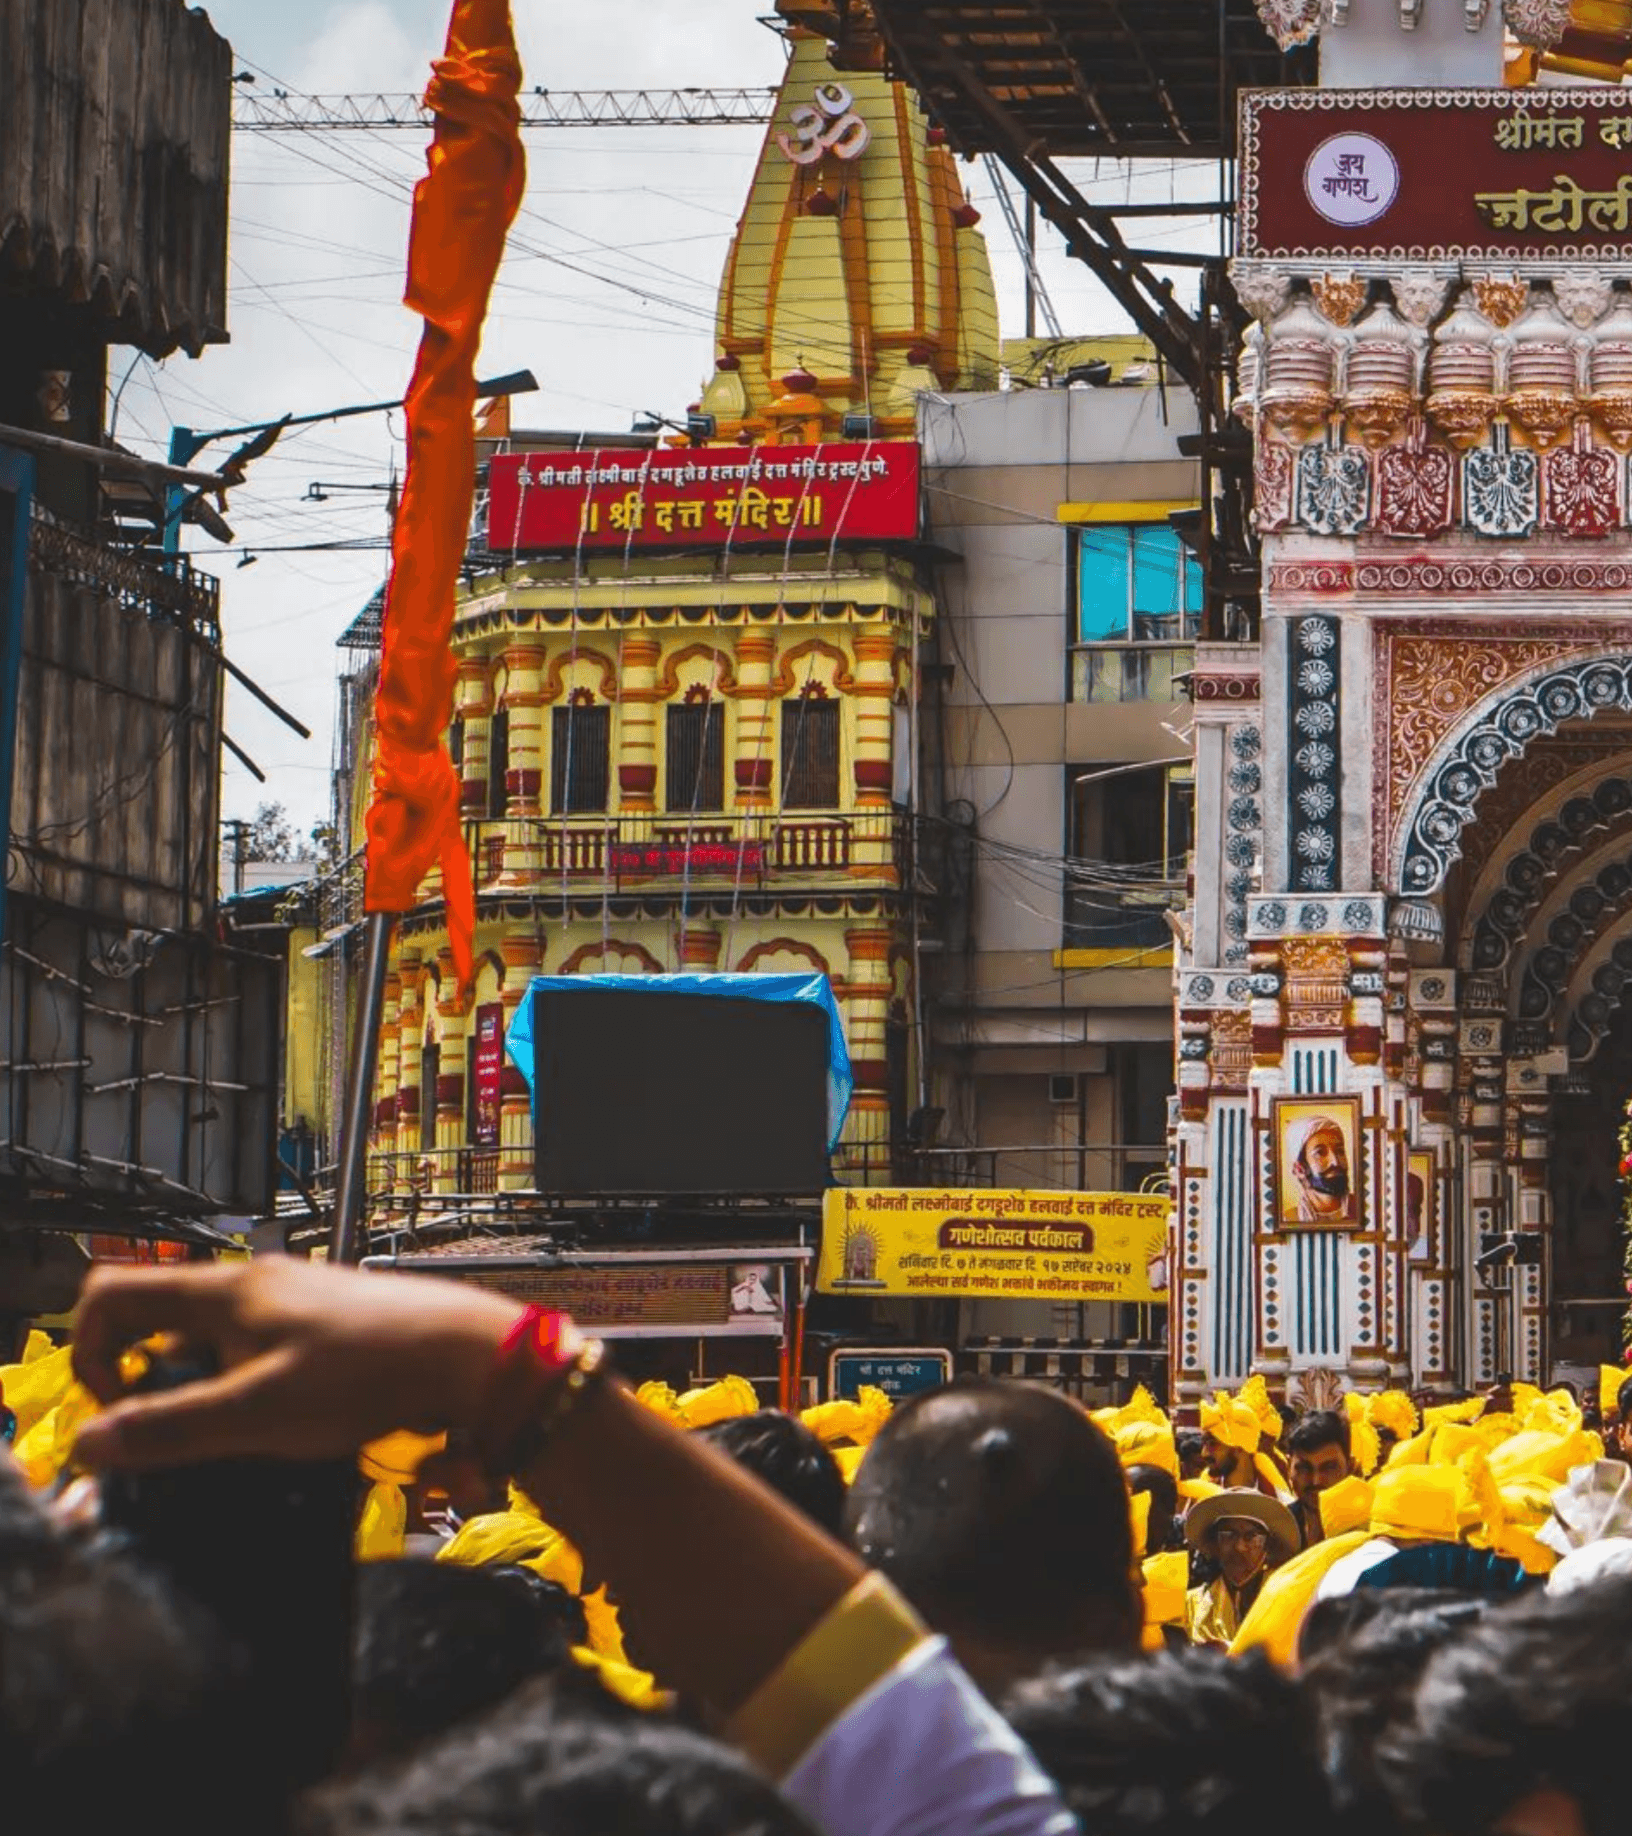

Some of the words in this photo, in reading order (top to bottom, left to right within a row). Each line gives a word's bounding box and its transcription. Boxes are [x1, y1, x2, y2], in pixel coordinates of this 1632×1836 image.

[1493, 105, 1584, 150] श्रीमंत
[1333, 154, 1365, 177] जय
[1322, 174, 1380, 203] गणेश
[539, 465, 582, 486] श्रीमती
[651, 461, 707, 487] दगडूशेठ
[711, 459, 762, 481] हलवाई
[765, 463, 788, 480] दत्त
[791, 457, 827, 477] मंदिर
[829, 461, 858, 481] ट्रस्ट
[609, 491, 646, 530] श्री
[655, 501, 706, 532] दत्त
[714, 486, 794, 529] मंदिर
[866, 1193, 908, 1211] श्रीमती
[1030, 1197, 1073, 1215] हलवाई
[1076, 1200, 1095, 1215] दत्त
[1099, 1198, 1133, 1216] मंदिर
[949, 1223, 1025, 1246] गणेशोत्सव
[1028, 1225, 1084, 1249] पर्वकाल
